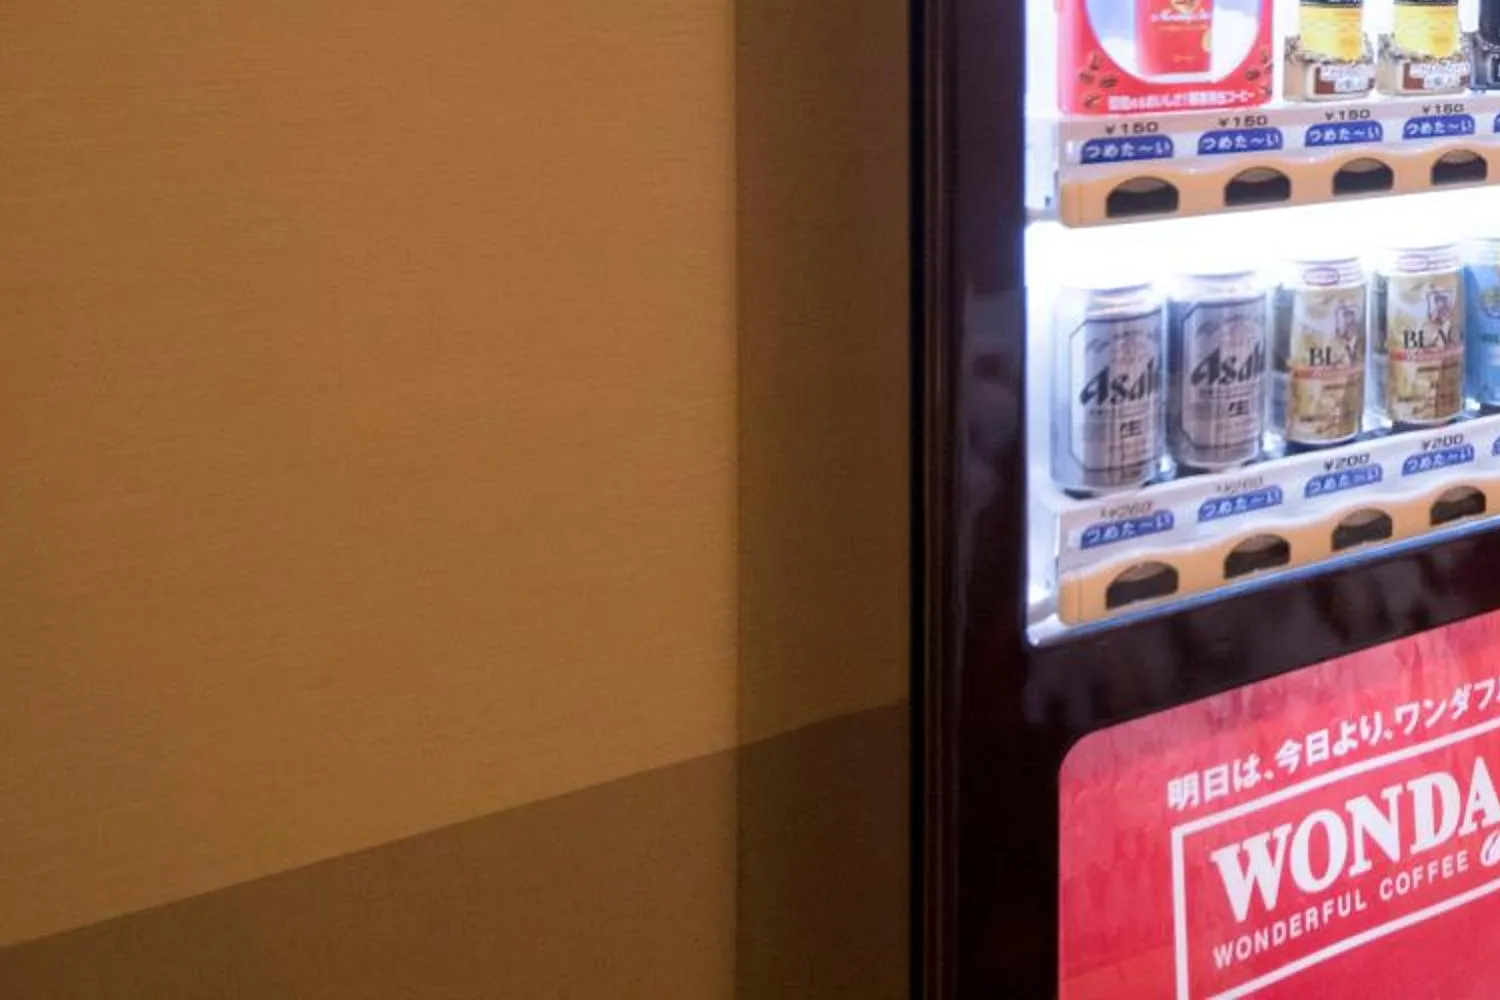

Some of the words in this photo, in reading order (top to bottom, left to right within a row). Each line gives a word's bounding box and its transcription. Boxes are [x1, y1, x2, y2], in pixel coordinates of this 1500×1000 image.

[1086, 141, 1171, 159] つめた〜い
[1212, 889, 1367, 970] WONDERFUL
[1379, 850, 1470, 902] COFFEE
